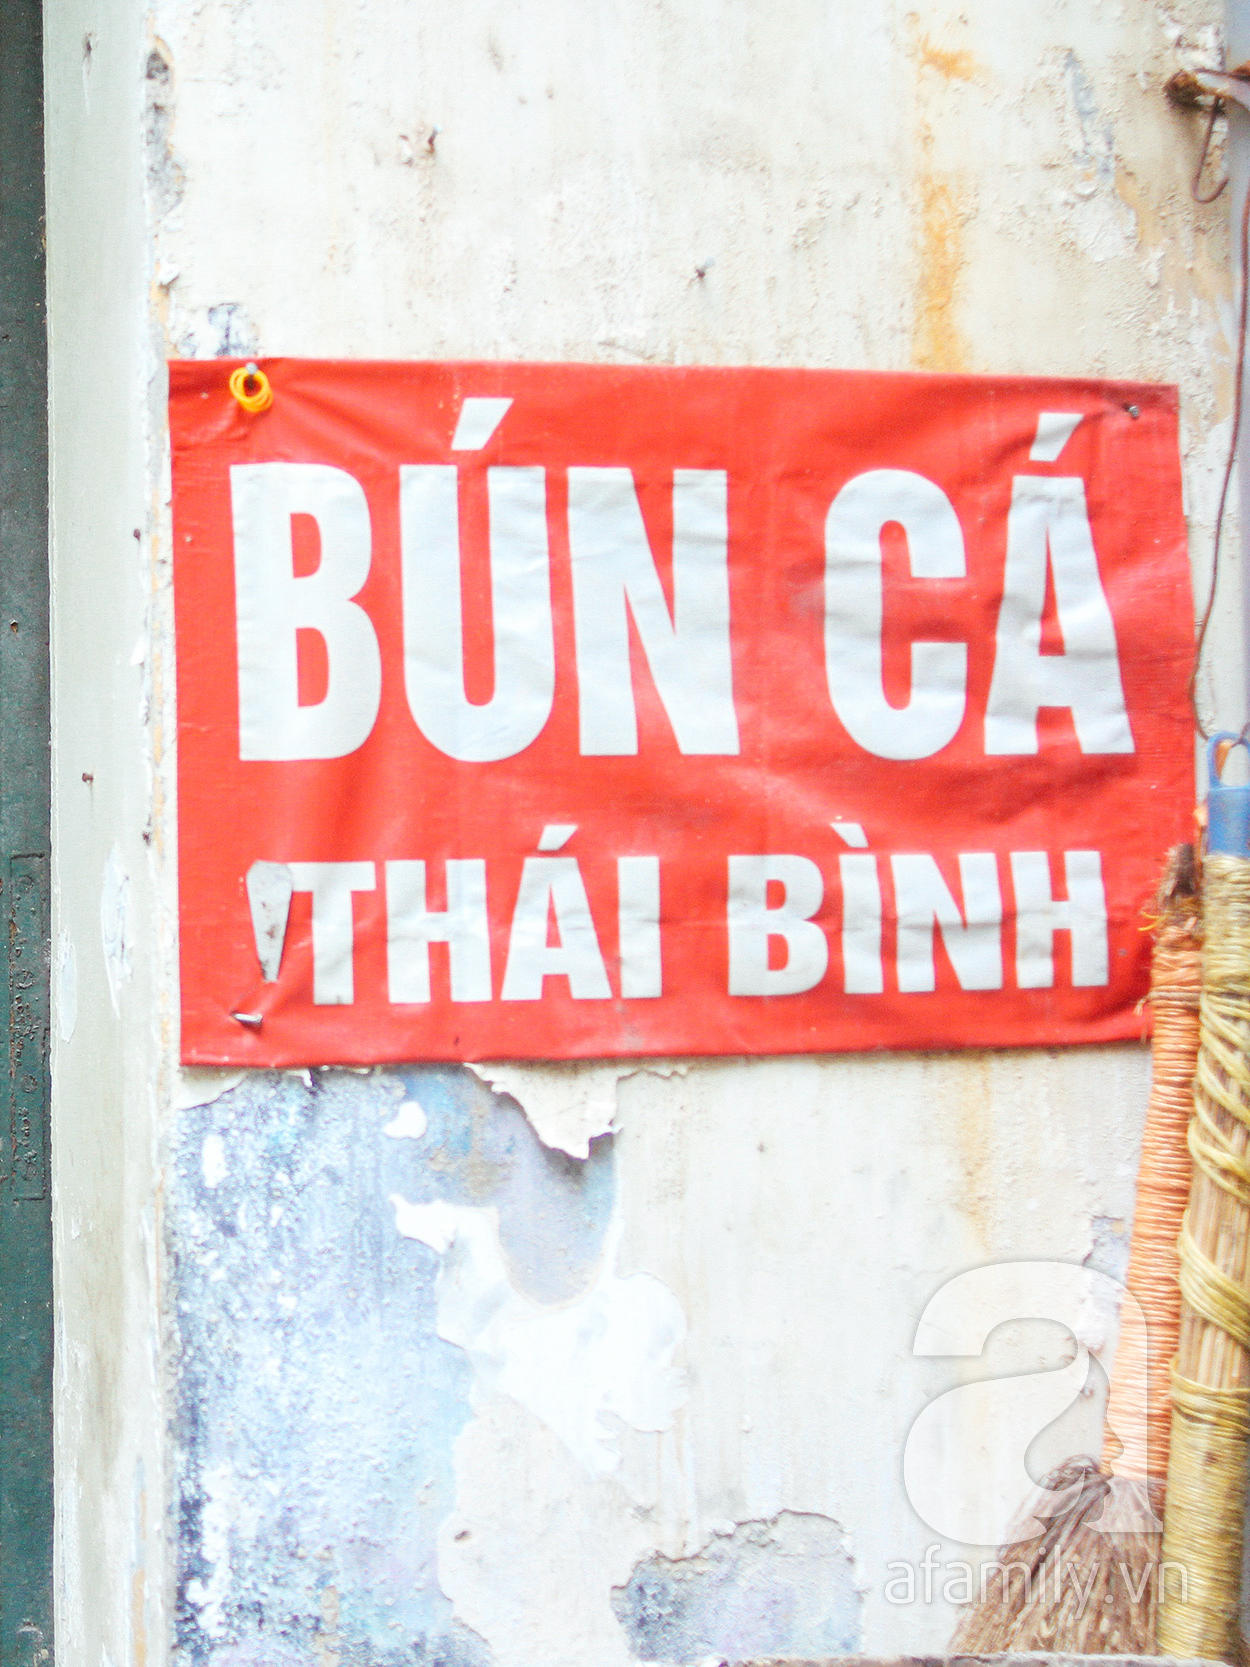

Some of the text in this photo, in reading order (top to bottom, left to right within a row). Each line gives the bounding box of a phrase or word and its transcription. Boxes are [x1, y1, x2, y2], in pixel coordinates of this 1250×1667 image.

[229, 396, 1135, 763] BÚN CÁ
[290, 821, 1109, 1006] THÁI BÌNH
